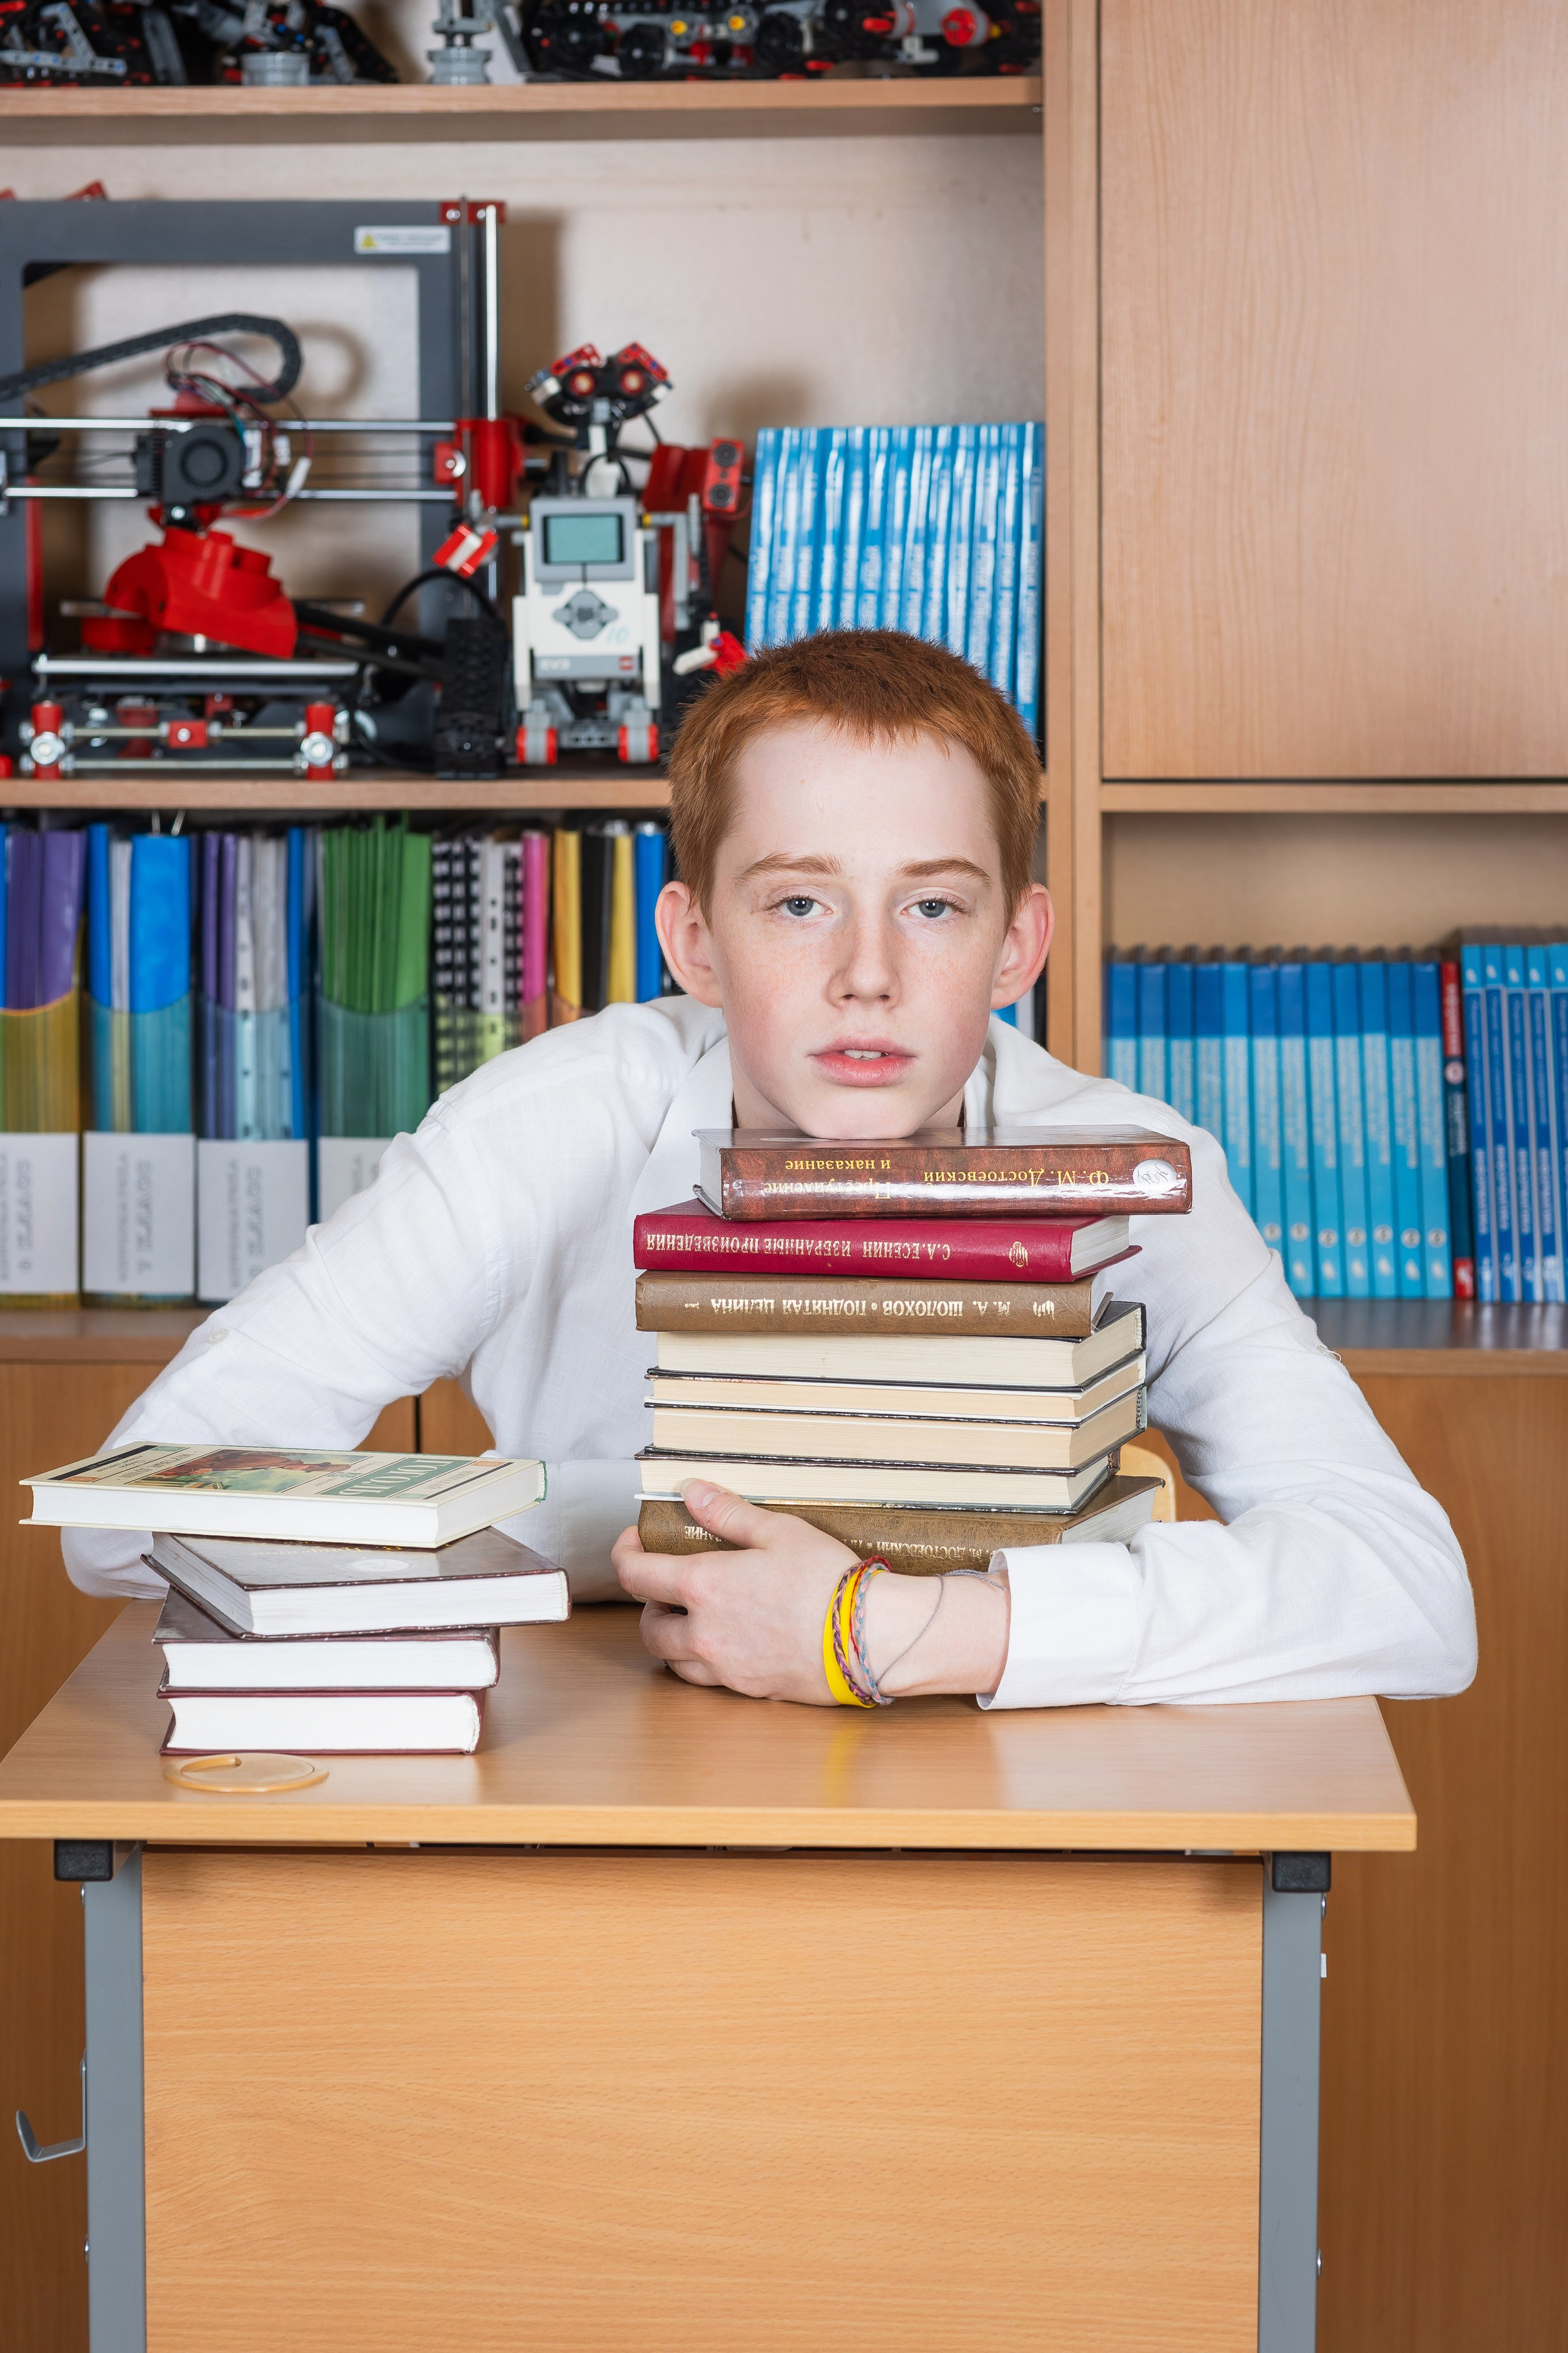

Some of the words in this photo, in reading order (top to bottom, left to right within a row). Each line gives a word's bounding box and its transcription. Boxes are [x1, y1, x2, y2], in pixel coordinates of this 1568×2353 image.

[785, 1160, 876, 1170] наказание
[881, 1160, 891, 1169] и
[923, 1168, 1045, 1187] Достоевский
[1052, 1171, 1075, 1186] М.
[1083, 1170, 1109, 1185] Ф.
[763, 1178, 891, 1199] Преступление
[647, 1233, 760, 1254] ПРОИЗВЕДЕНИЯ
[764, 1238, 851, 1257] ИЗБРАННЫЕ
[710, 1297, 775, 1315] ЦЕЛИНА
[782, 1298, 867, 1316] ПОДНЯТАЯ
[882, 1300, 963, 1316] ШОЛОХОВ
[972, 1301, 989, 1316] А.
[993, 1301, 1011, 1316] М.
[339, 1459, 456, 1496] ГОГОЛЬ
[876, 1541, 966, 1561] ДОСТОЕВСКИЙ
